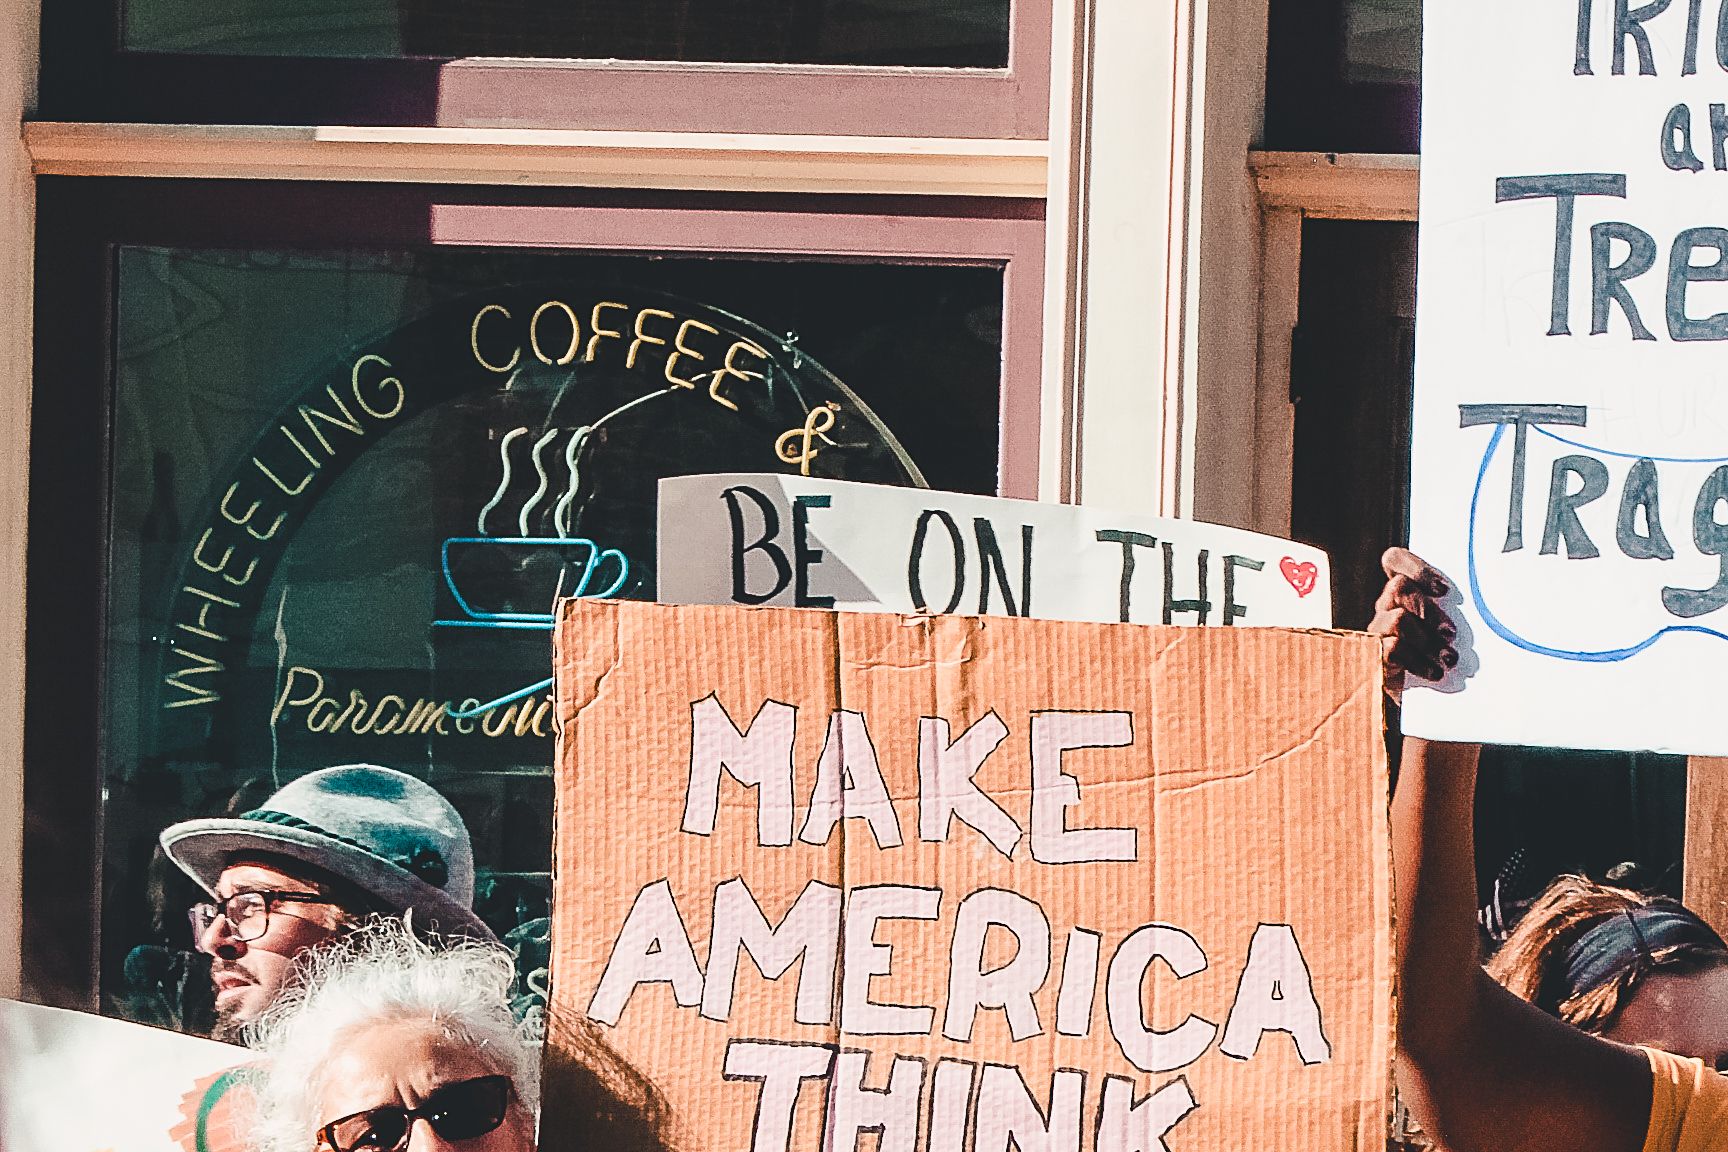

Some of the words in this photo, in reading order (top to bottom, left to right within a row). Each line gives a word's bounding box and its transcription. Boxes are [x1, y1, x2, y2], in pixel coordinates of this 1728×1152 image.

[163, 353, 406, 709] WHEELING
[470, 300, 767, 411] COFFEE
[721, 486, 836, 608] BE
[909, 509, 1034, 617] ON
[680, 692, 1139, 864] MAKE
[588, 876, 1332, 1072] AMERICA
